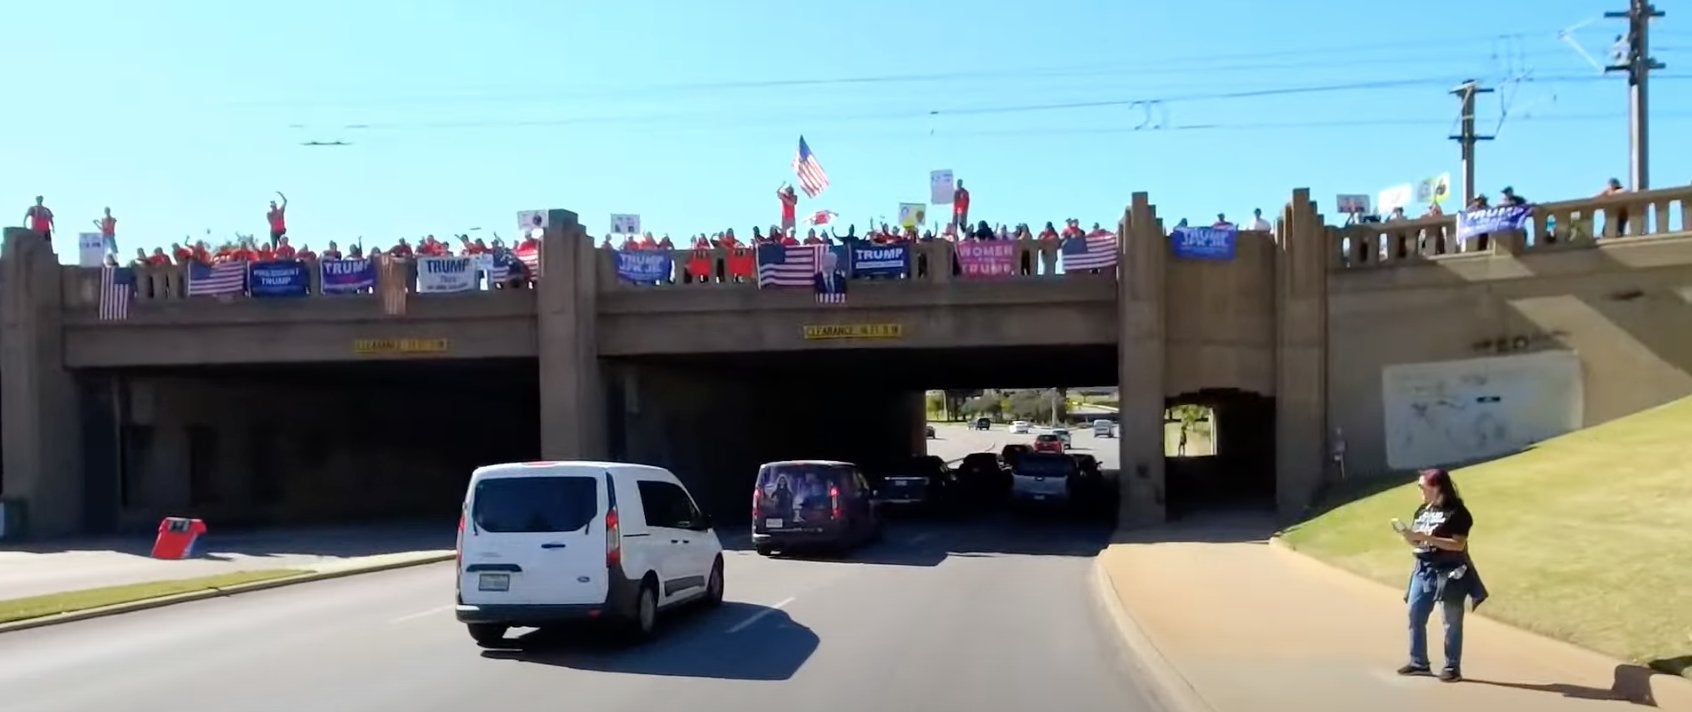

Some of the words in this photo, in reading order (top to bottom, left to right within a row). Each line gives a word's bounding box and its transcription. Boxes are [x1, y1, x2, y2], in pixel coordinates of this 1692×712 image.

[856, 247, 904, 260] TRUMP
[960, 245, 1013, 257] WOMEN
[426, 258, 470, 274] TRUMP
[261, 276, 291, 285] TRUMP
